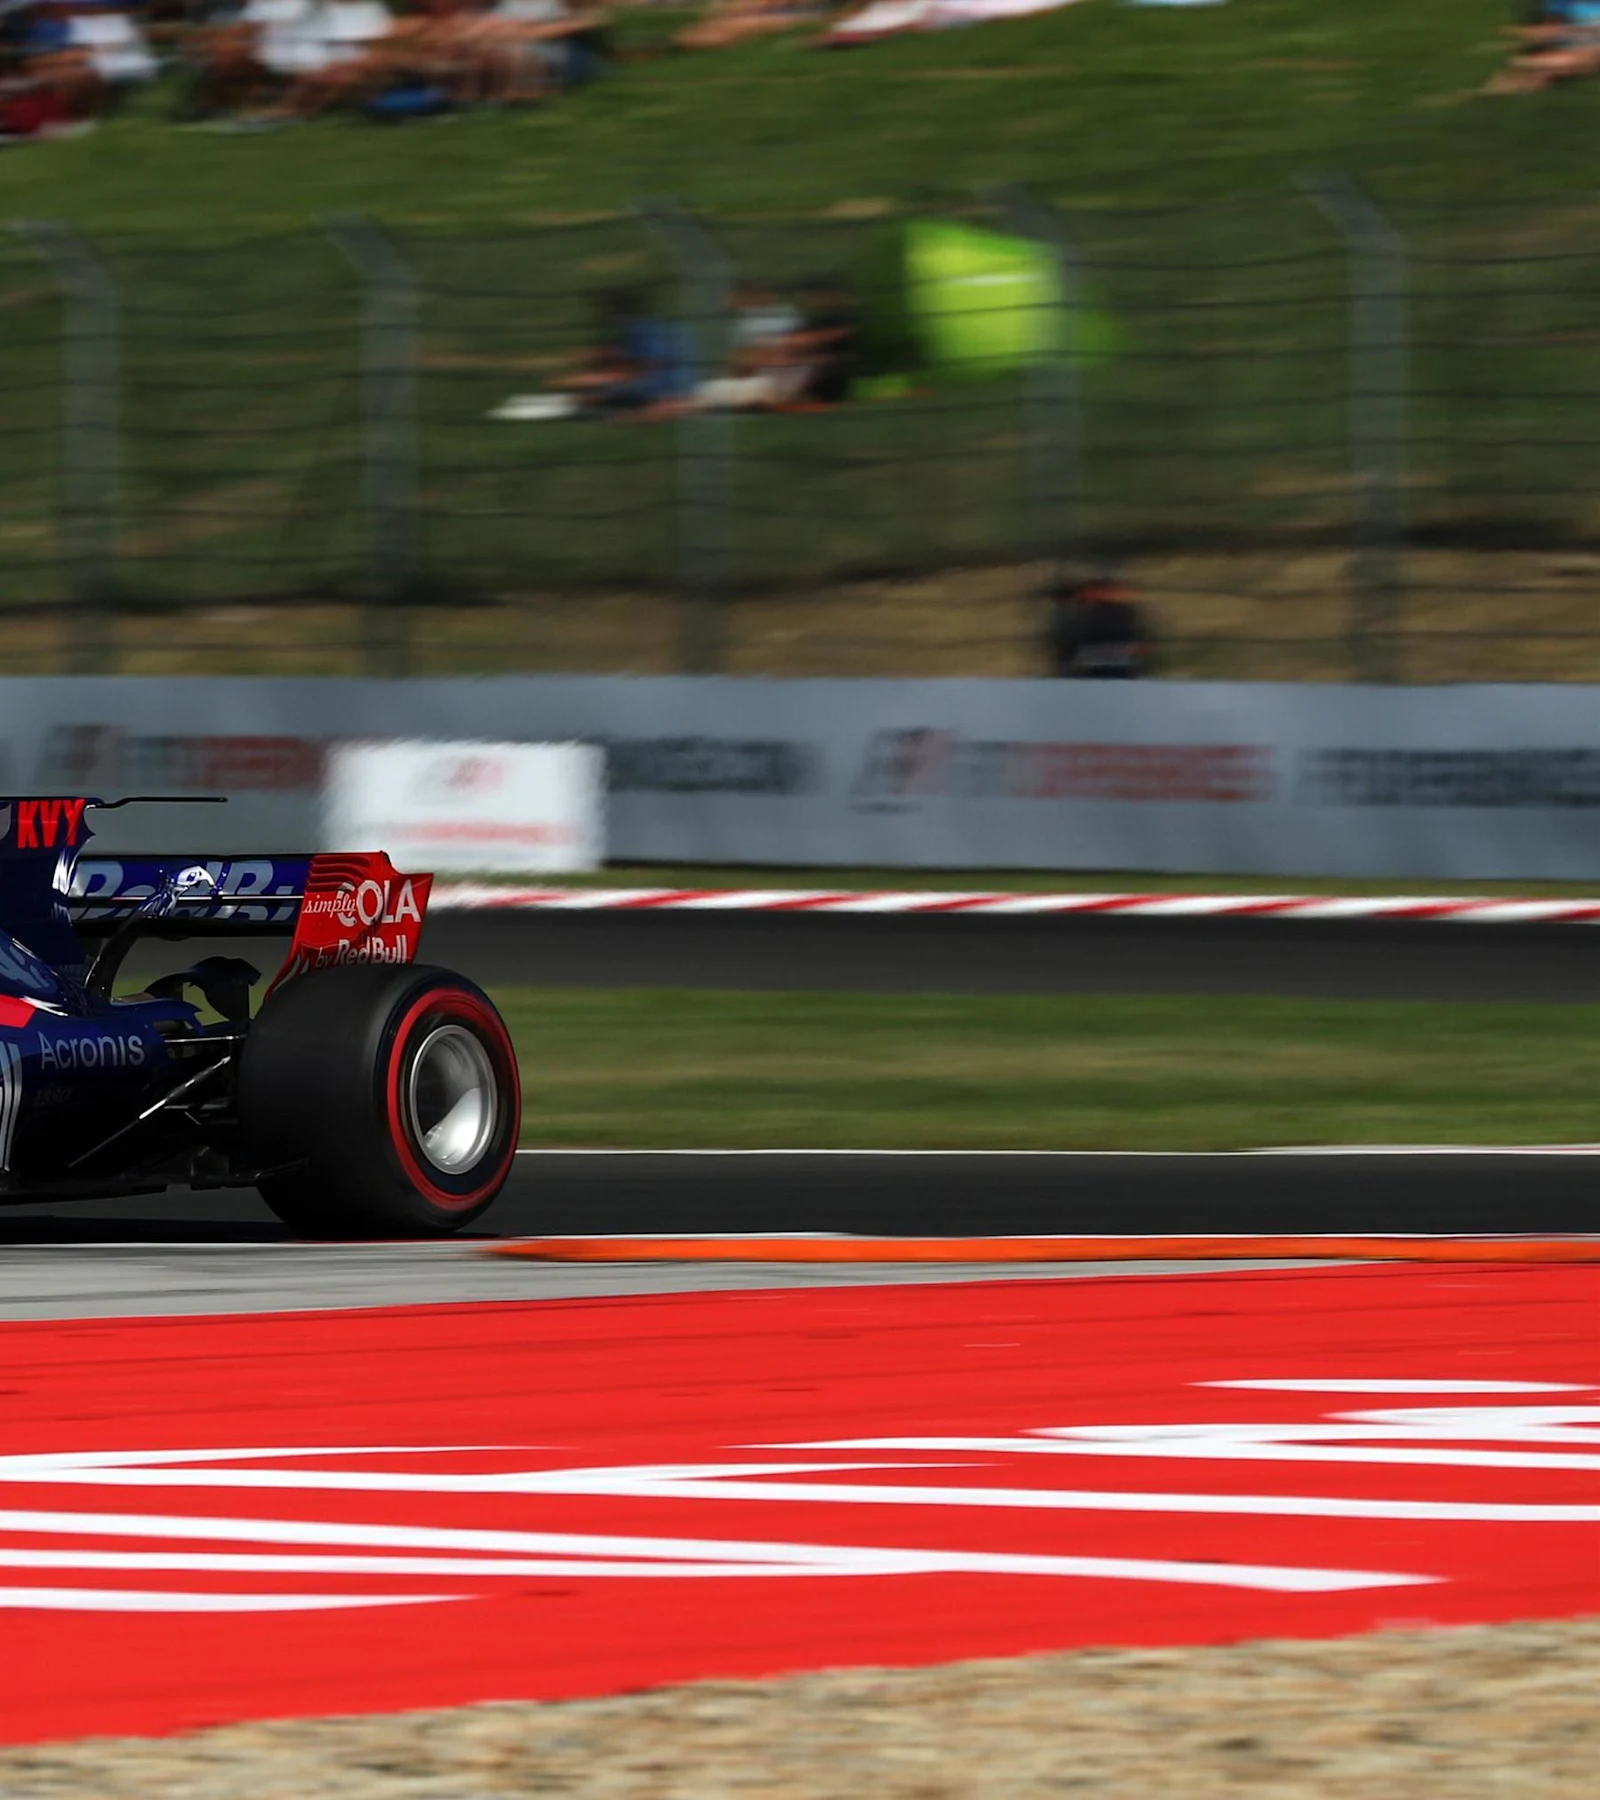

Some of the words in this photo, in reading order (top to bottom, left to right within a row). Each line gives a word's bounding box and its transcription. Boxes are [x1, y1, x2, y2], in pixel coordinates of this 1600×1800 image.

[17, 799, 86, 849] KVY
[302, 894, 357, 918] simply
[336, 879, 422, 927] COLA
[37, 1031, 146, 1070] Acronis
